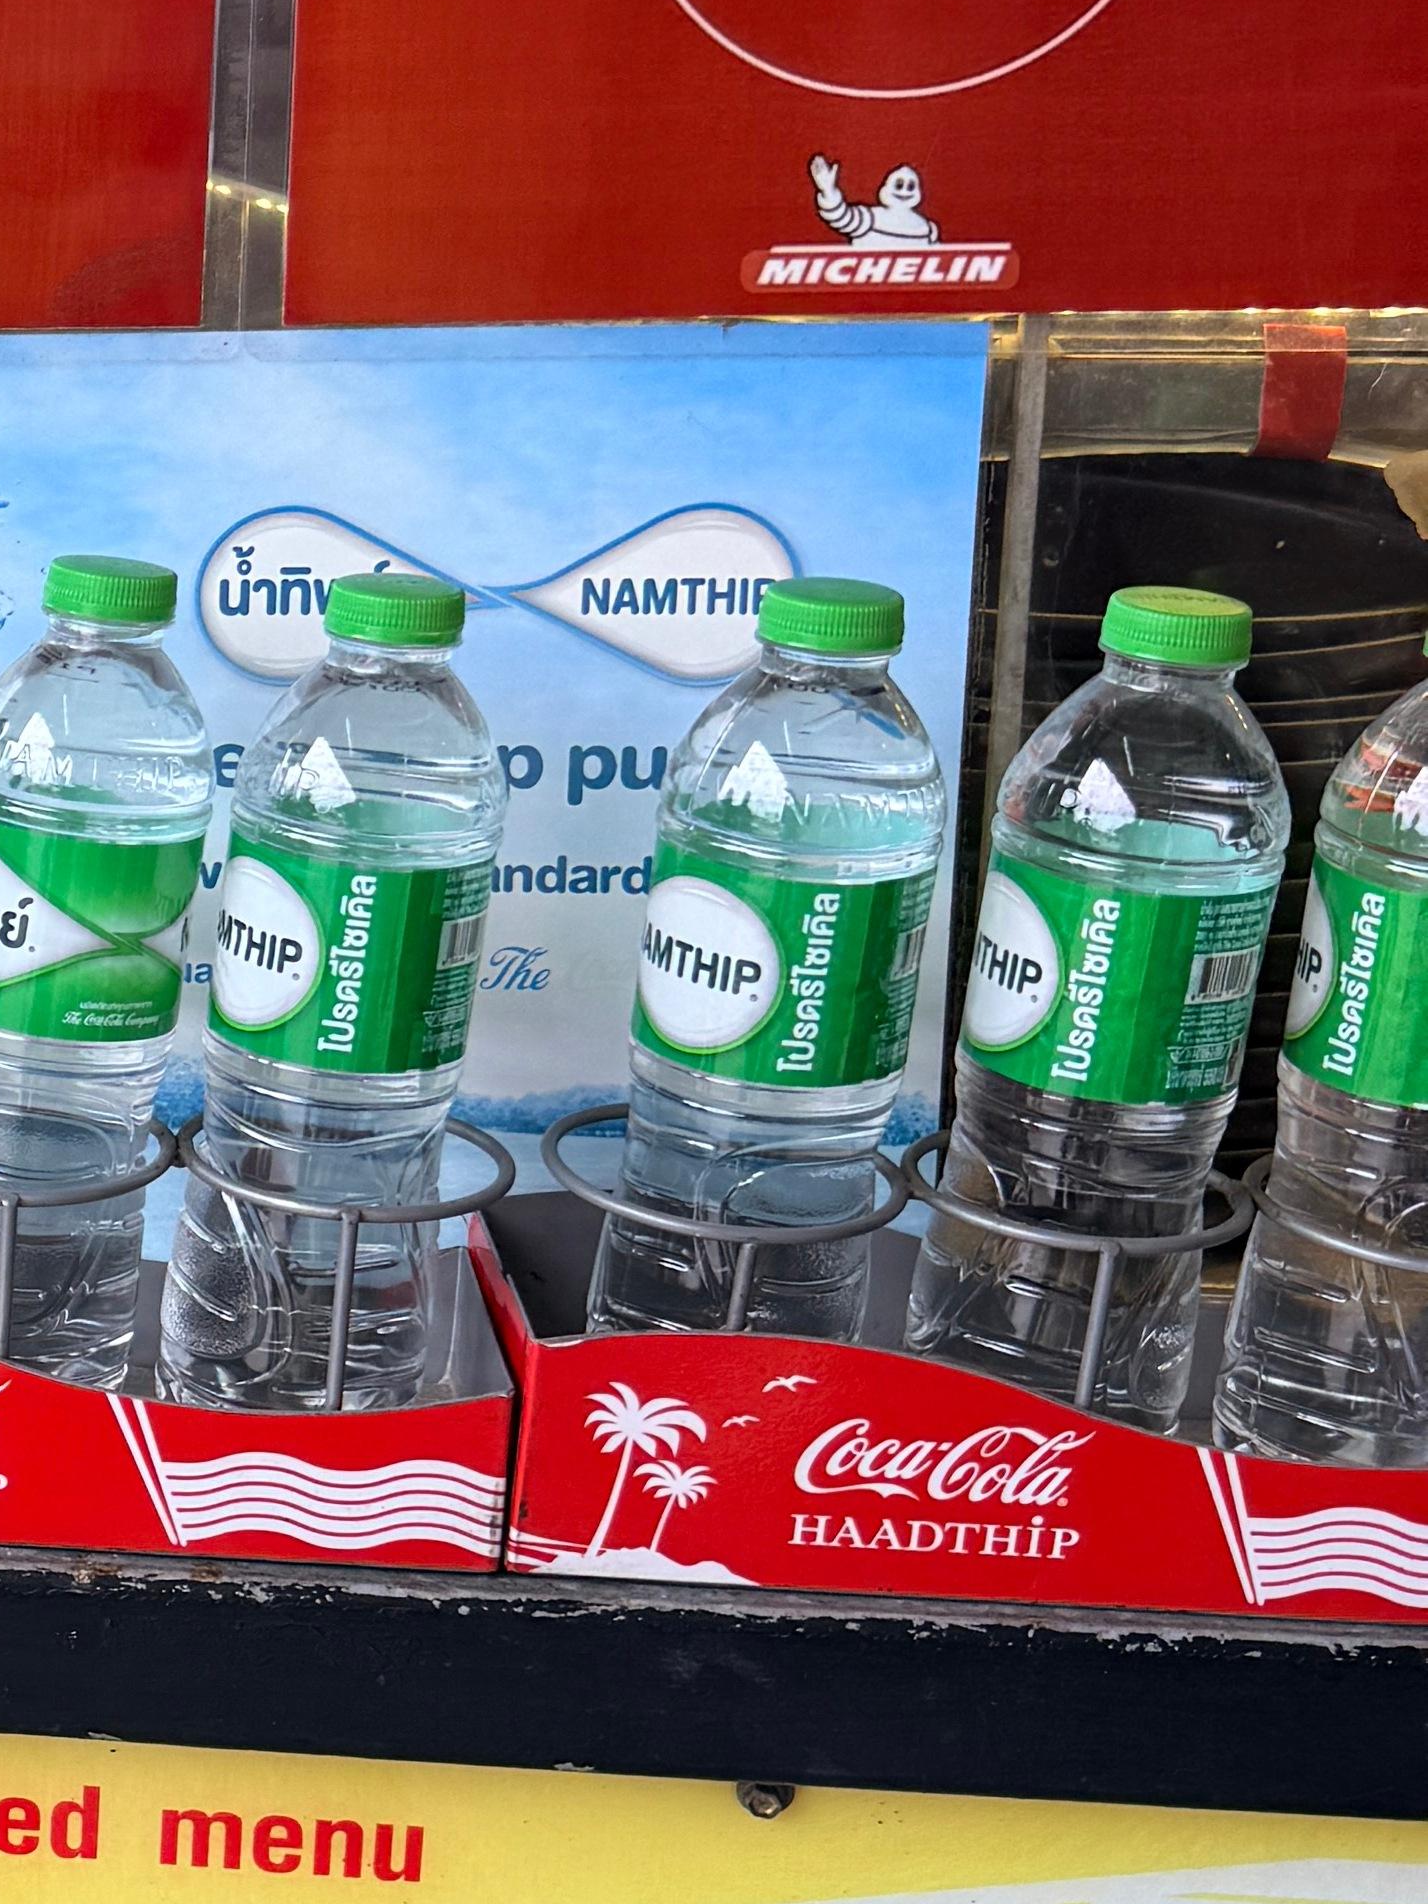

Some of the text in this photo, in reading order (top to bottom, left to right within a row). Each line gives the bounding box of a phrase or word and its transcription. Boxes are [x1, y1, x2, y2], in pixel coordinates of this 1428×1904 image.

[761, 257, 1003, 283] MICHELIN
[317, 874, 377, 1053] โปรดรีไซเคิล
[481, 945, 550, 992] The
[777, 893, 841, 1073] โปรดรีไซเคิล
[1052, 899, 1121, 1083] โปรดรีไซเคิล
[1324, 892, 1386, 1076] โปรดรีไซเคิล
[795, 1418, 1096, 1506] Coca-Cola
[159, 1808, 424, 1884] menu
